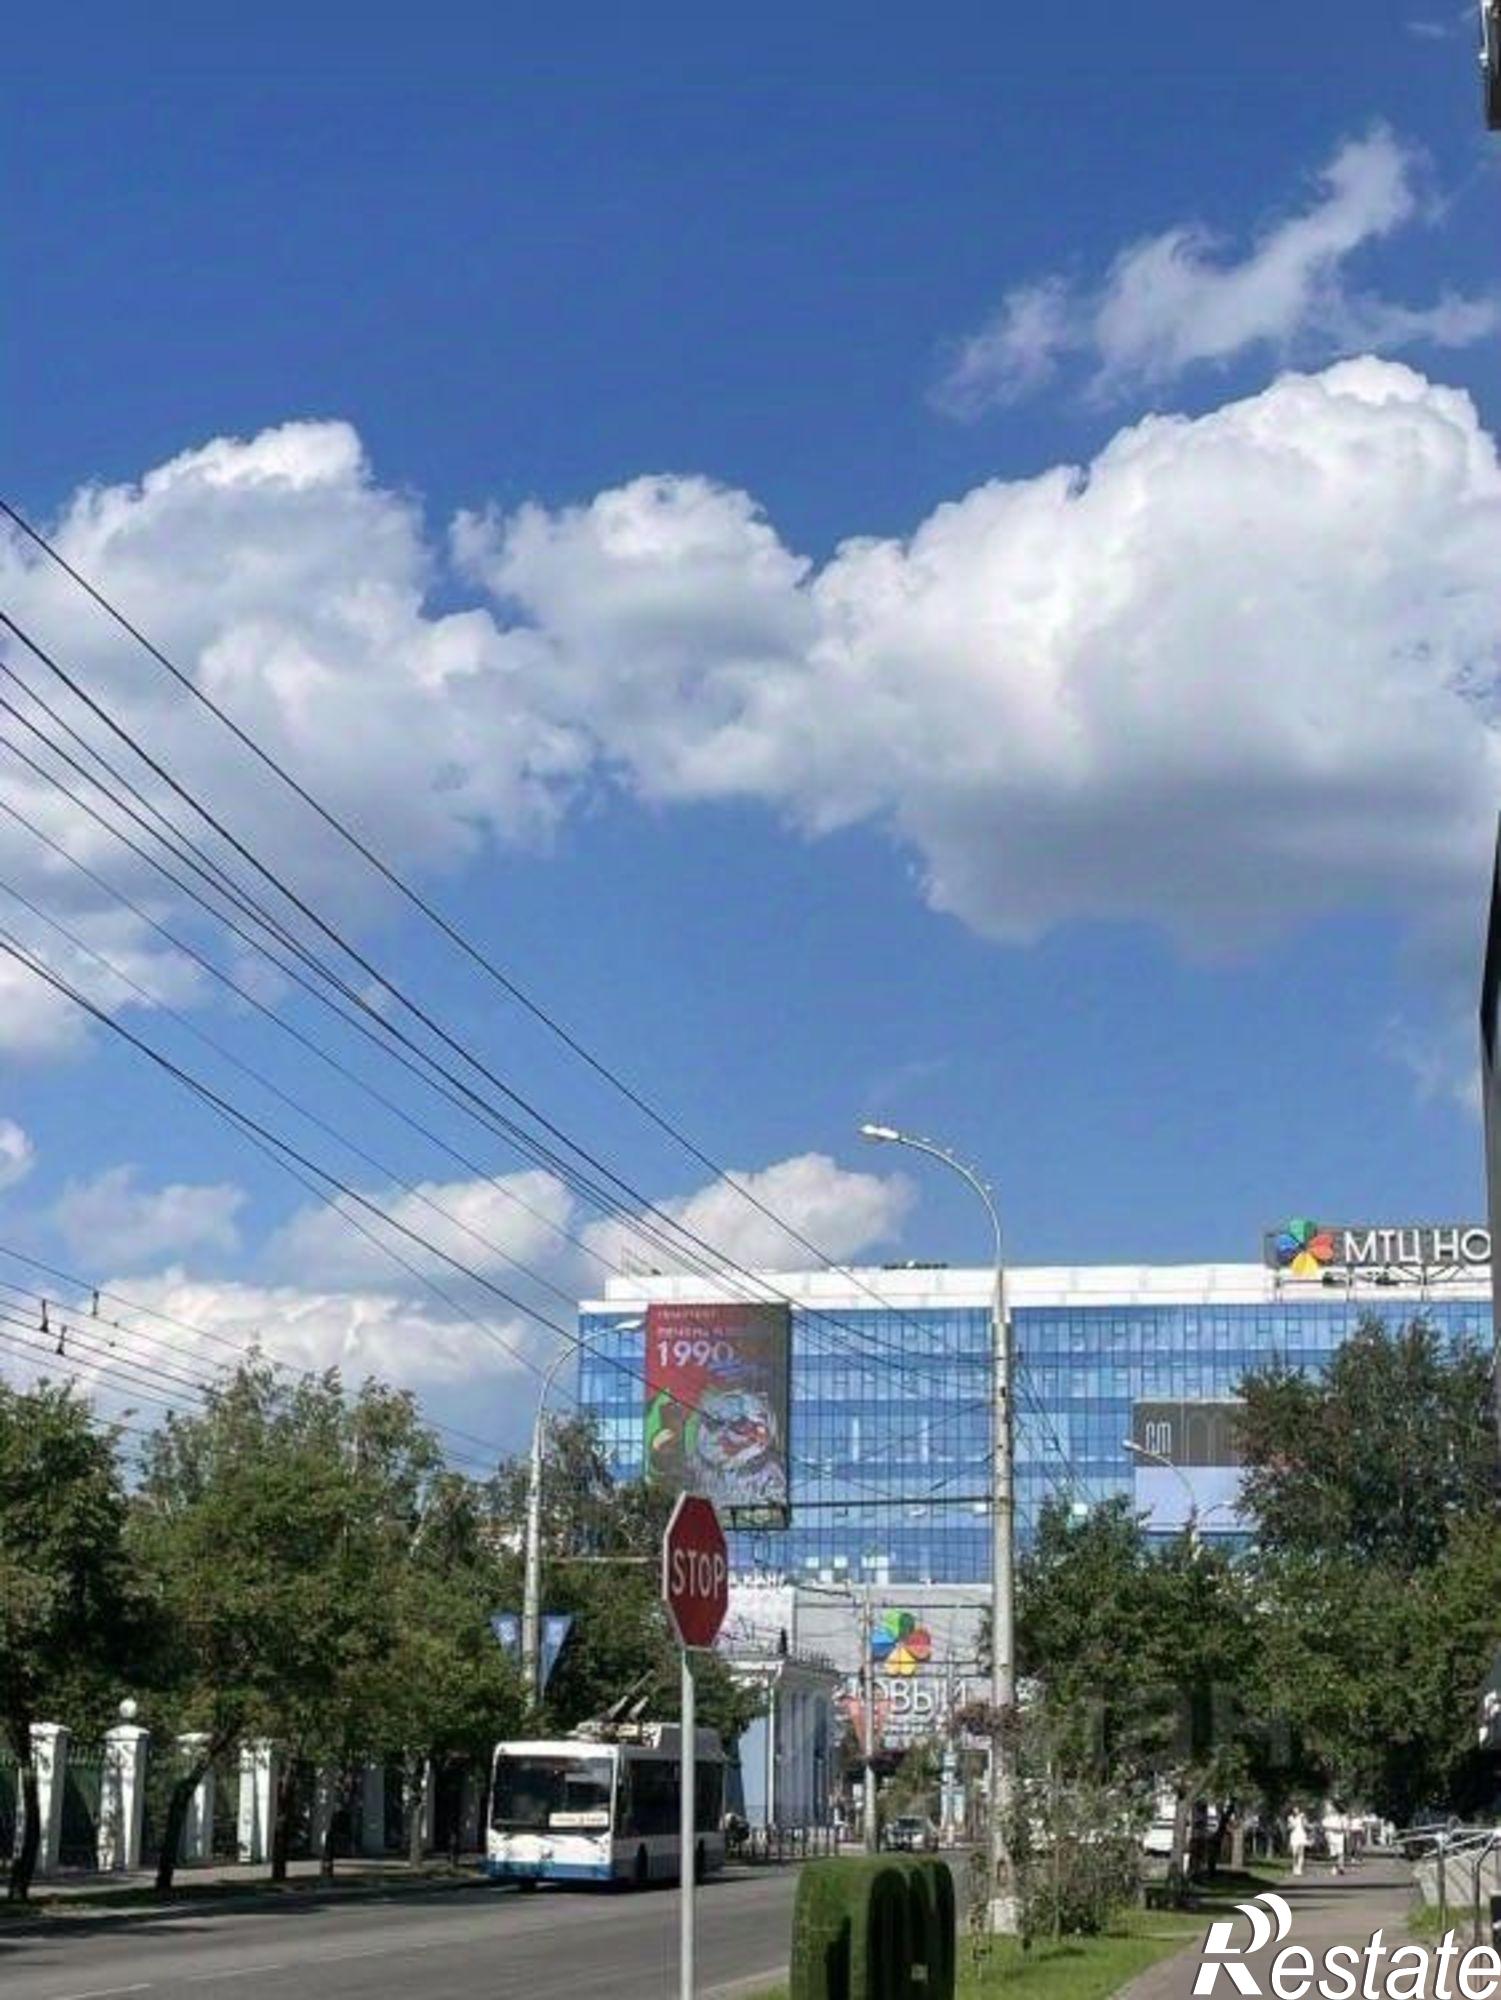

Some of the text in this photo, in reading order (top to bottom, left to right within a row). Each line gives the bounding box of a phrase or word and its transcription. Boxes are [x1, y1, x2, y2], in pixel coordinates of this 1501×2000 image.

[1344, 1229, 1423, 1264] МТЦ
[657, 1339, 734, 1367] 1990
[671, 1548, 725, 1599] STOP
